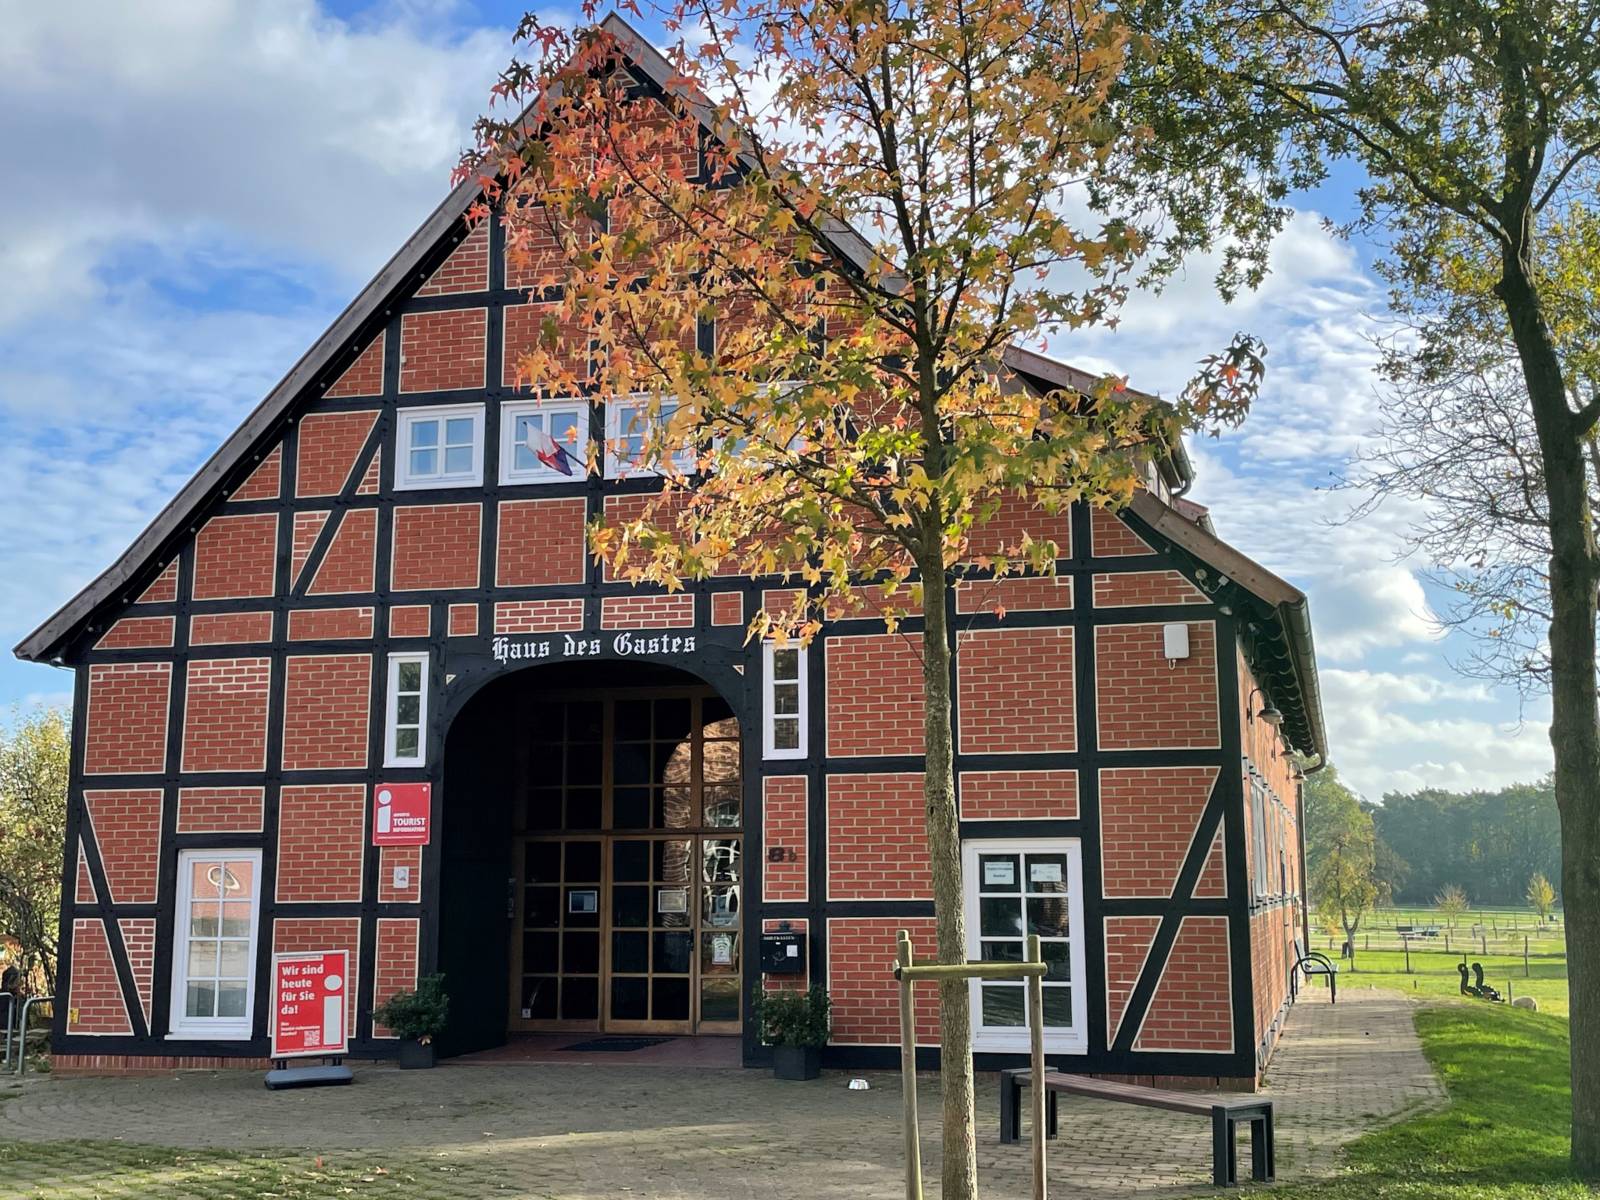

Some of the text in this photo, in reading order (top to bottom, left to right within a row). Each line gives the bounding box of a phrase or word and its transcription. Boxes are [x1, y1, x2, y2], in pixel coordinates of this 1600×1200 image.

[491, 632, 696, 664] Haus des Gastes
[393, 817, 426, 826] TOURIST
[282, 964, 324, 976] Wir sind
[281, 979, 312, 989] heute
[281, 990, 315, 1002] für Sie
[281, 1005, 298, 1015] da!
